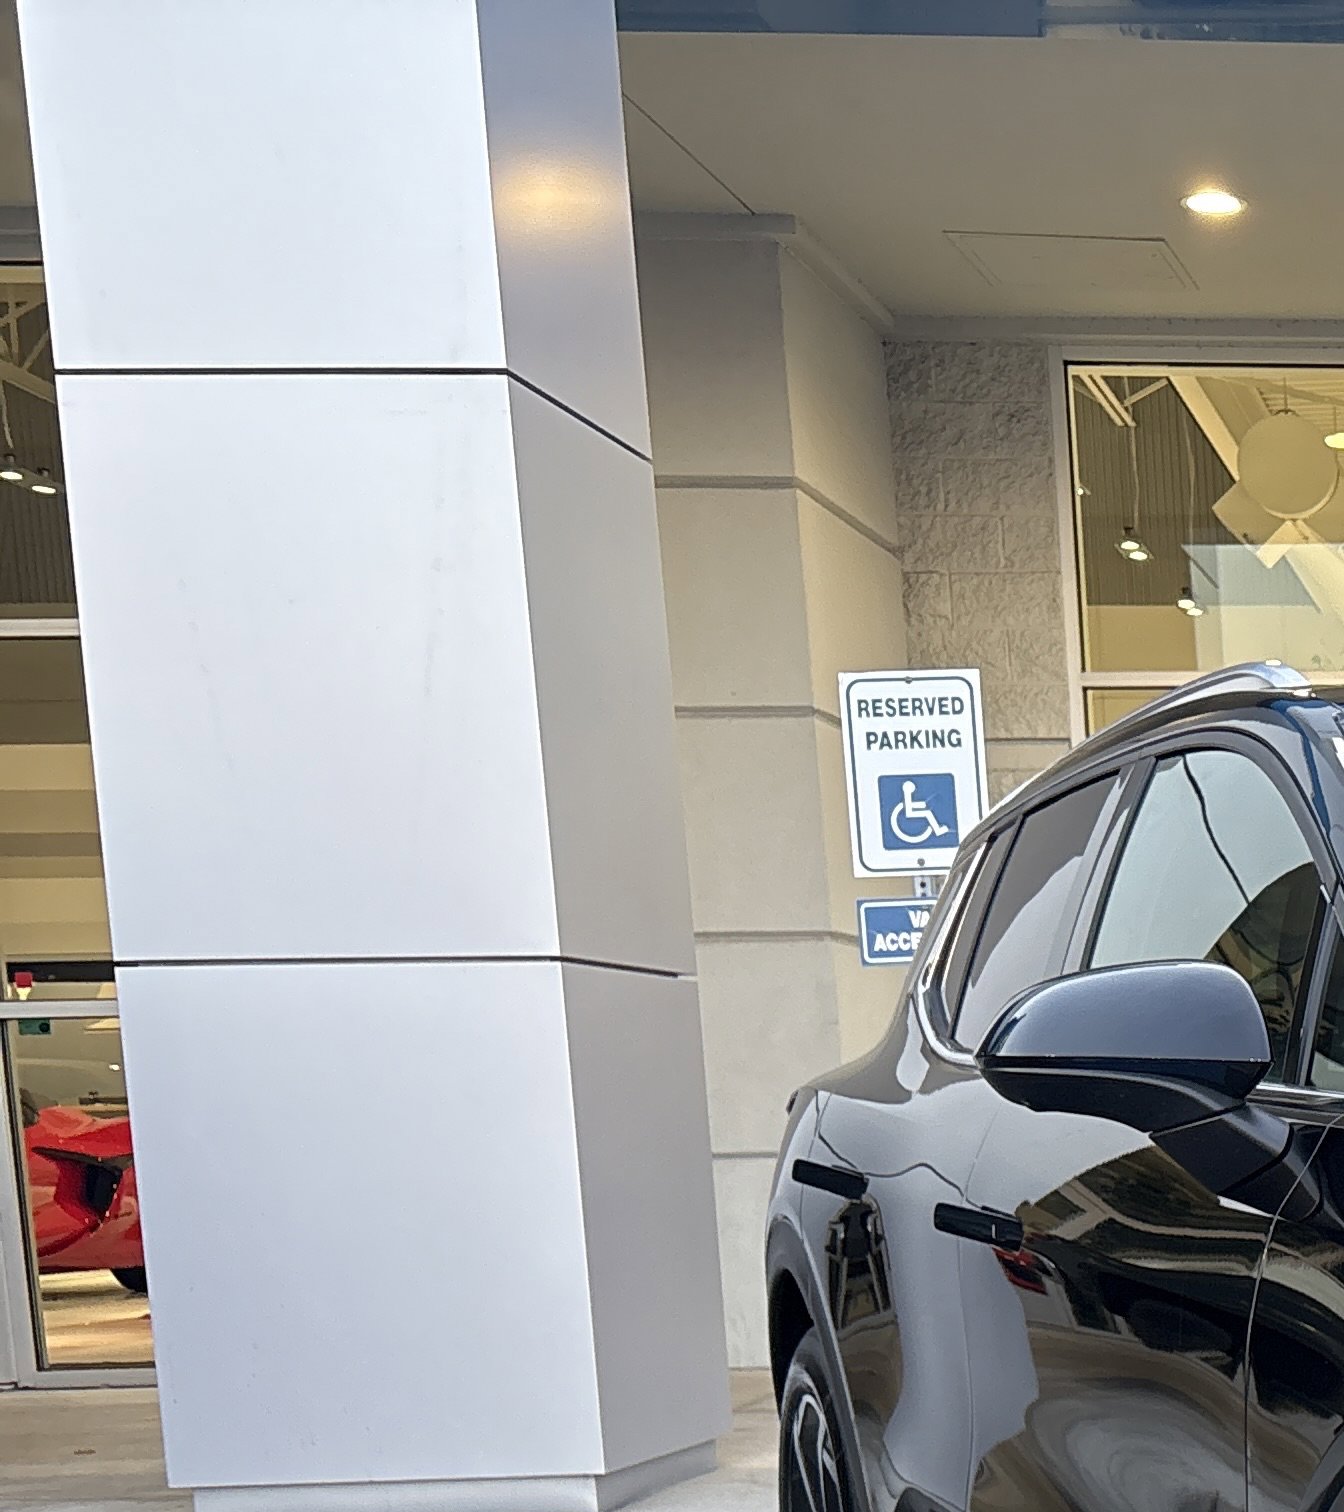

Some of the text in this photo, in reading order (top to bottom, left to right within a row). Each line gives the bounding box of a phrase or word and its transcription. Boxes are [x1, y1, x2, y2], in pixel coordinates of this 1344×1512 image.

[857, 696, 964, 717] RESERVED
[865, 728, 963, 751] PARKING
[908, 910, 931, 929] VA
[873, 931, 923, 952] ACCE
